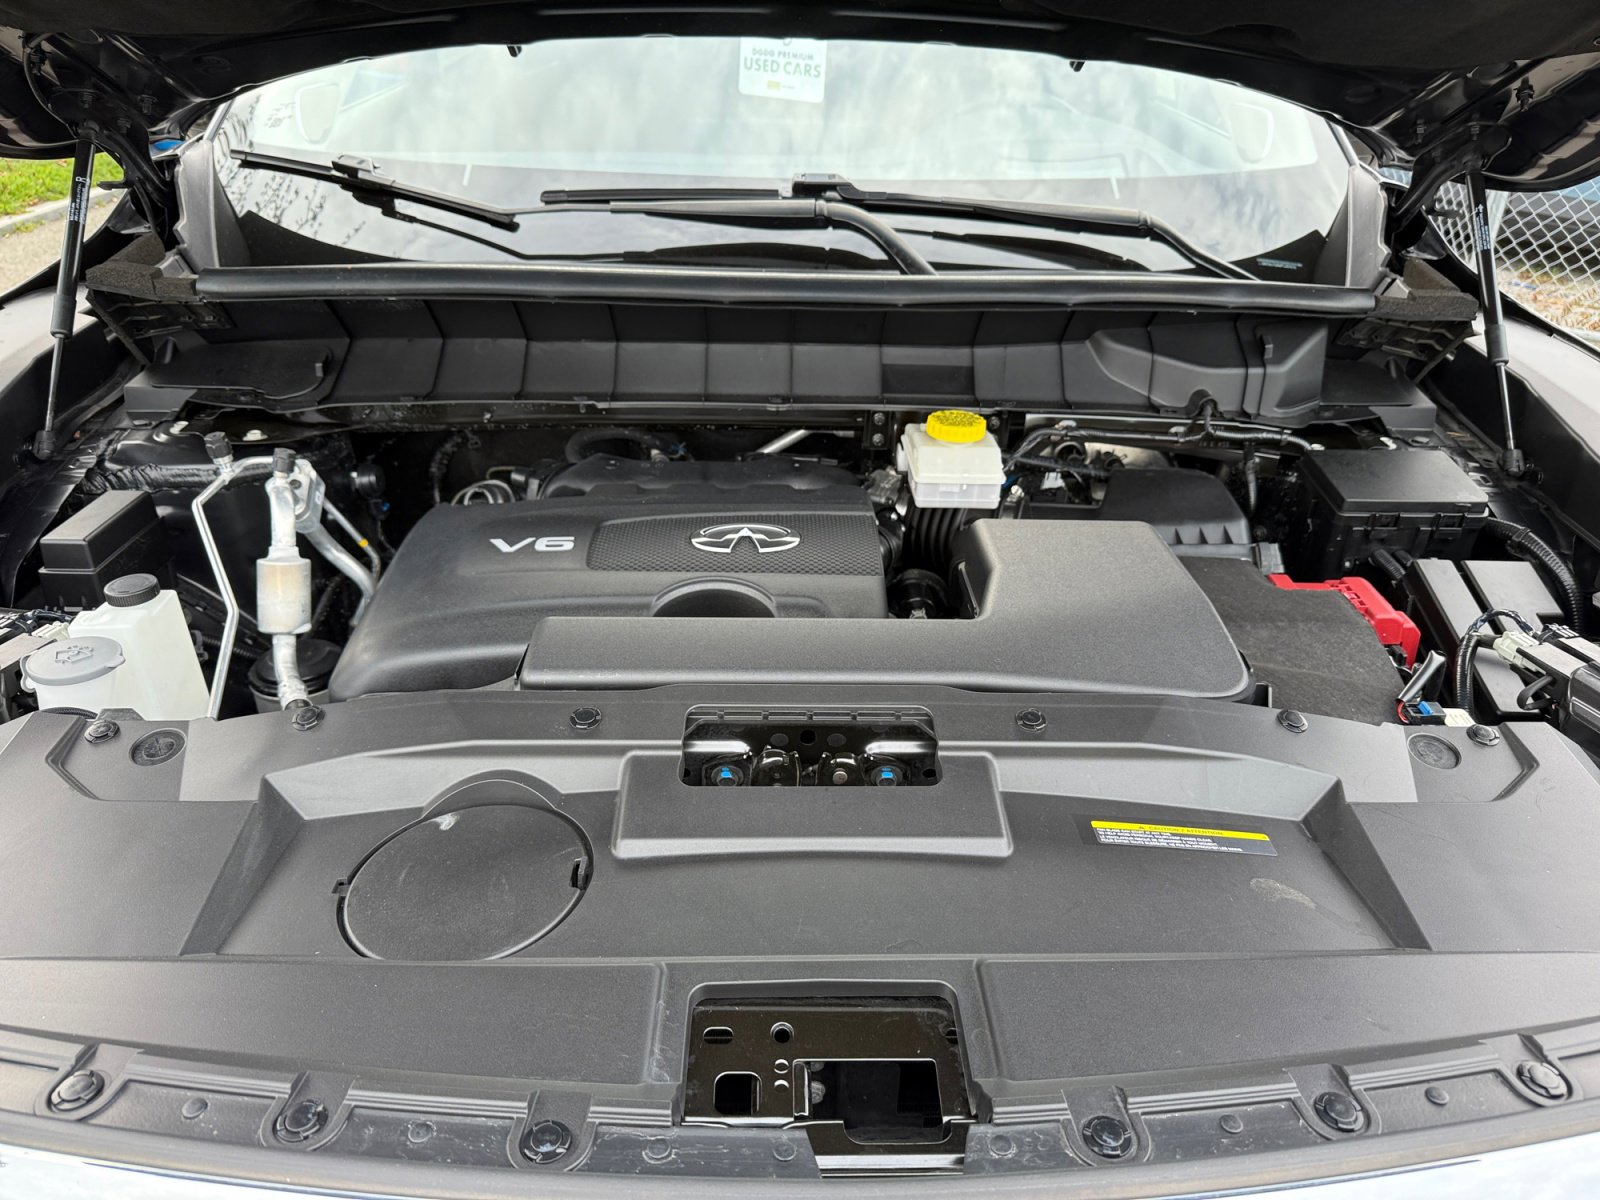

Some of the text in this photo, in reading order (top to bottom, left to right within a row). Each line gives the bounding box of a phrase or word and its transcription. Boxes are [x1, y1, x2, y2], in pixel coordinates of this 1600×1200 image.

[744, 56, 822, 78] USED CARS
[489, 536, 575, 553] V6
